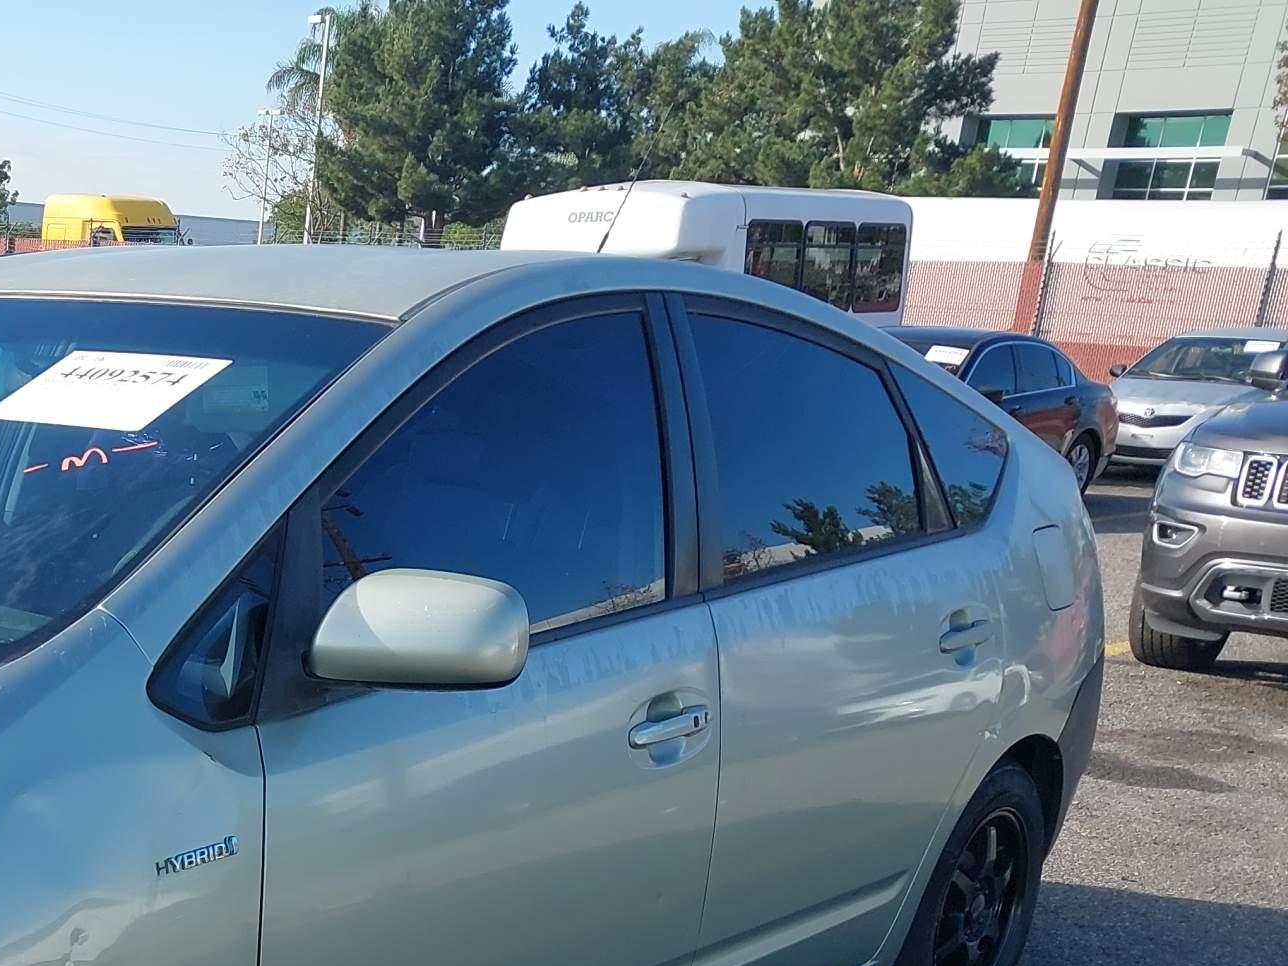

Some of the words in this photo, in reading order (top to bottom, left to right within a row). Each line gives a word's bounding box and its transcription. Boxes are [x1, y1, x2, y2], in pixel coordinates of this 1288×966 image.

[568, 210, 614, 223] OPARC
[60, 365, 190, 386] 44092574
[155, 843, 228, 877] HYBRID
